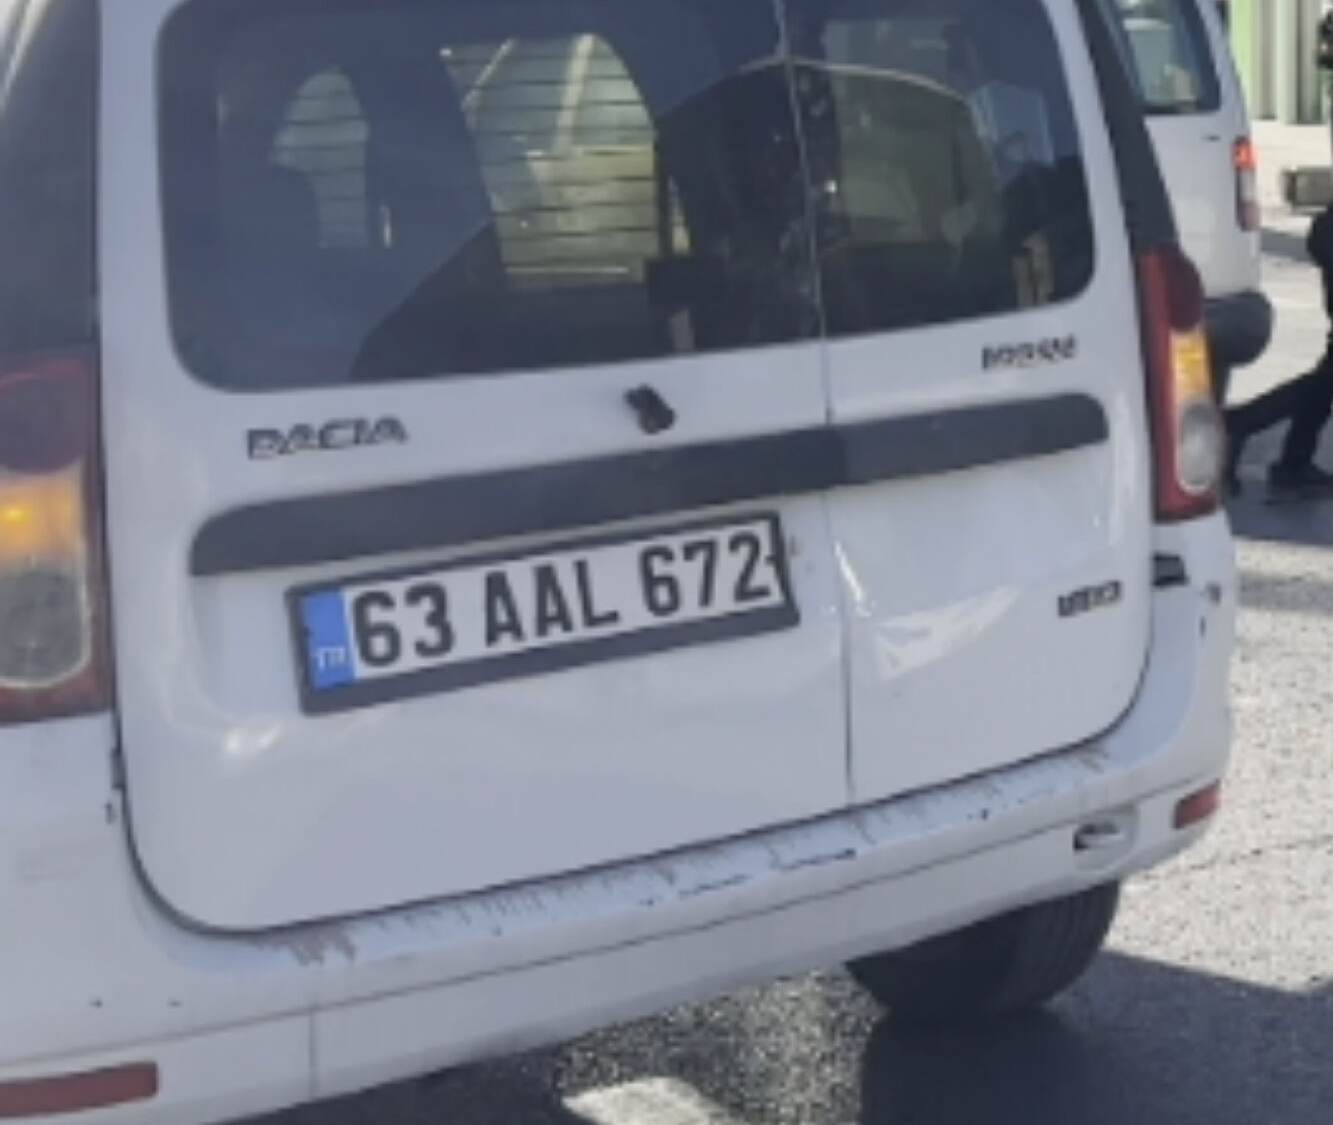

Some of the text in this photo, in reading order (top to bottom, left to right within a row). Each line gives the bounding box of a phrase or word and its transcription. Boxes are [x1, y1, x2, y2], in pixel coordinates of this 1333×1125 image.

[246, 414, 410, 461] DACIA
[352, 583, 455, 668] 63
[483, 558, 621, 648] AAL
[638, 530, 773, 617] 672
